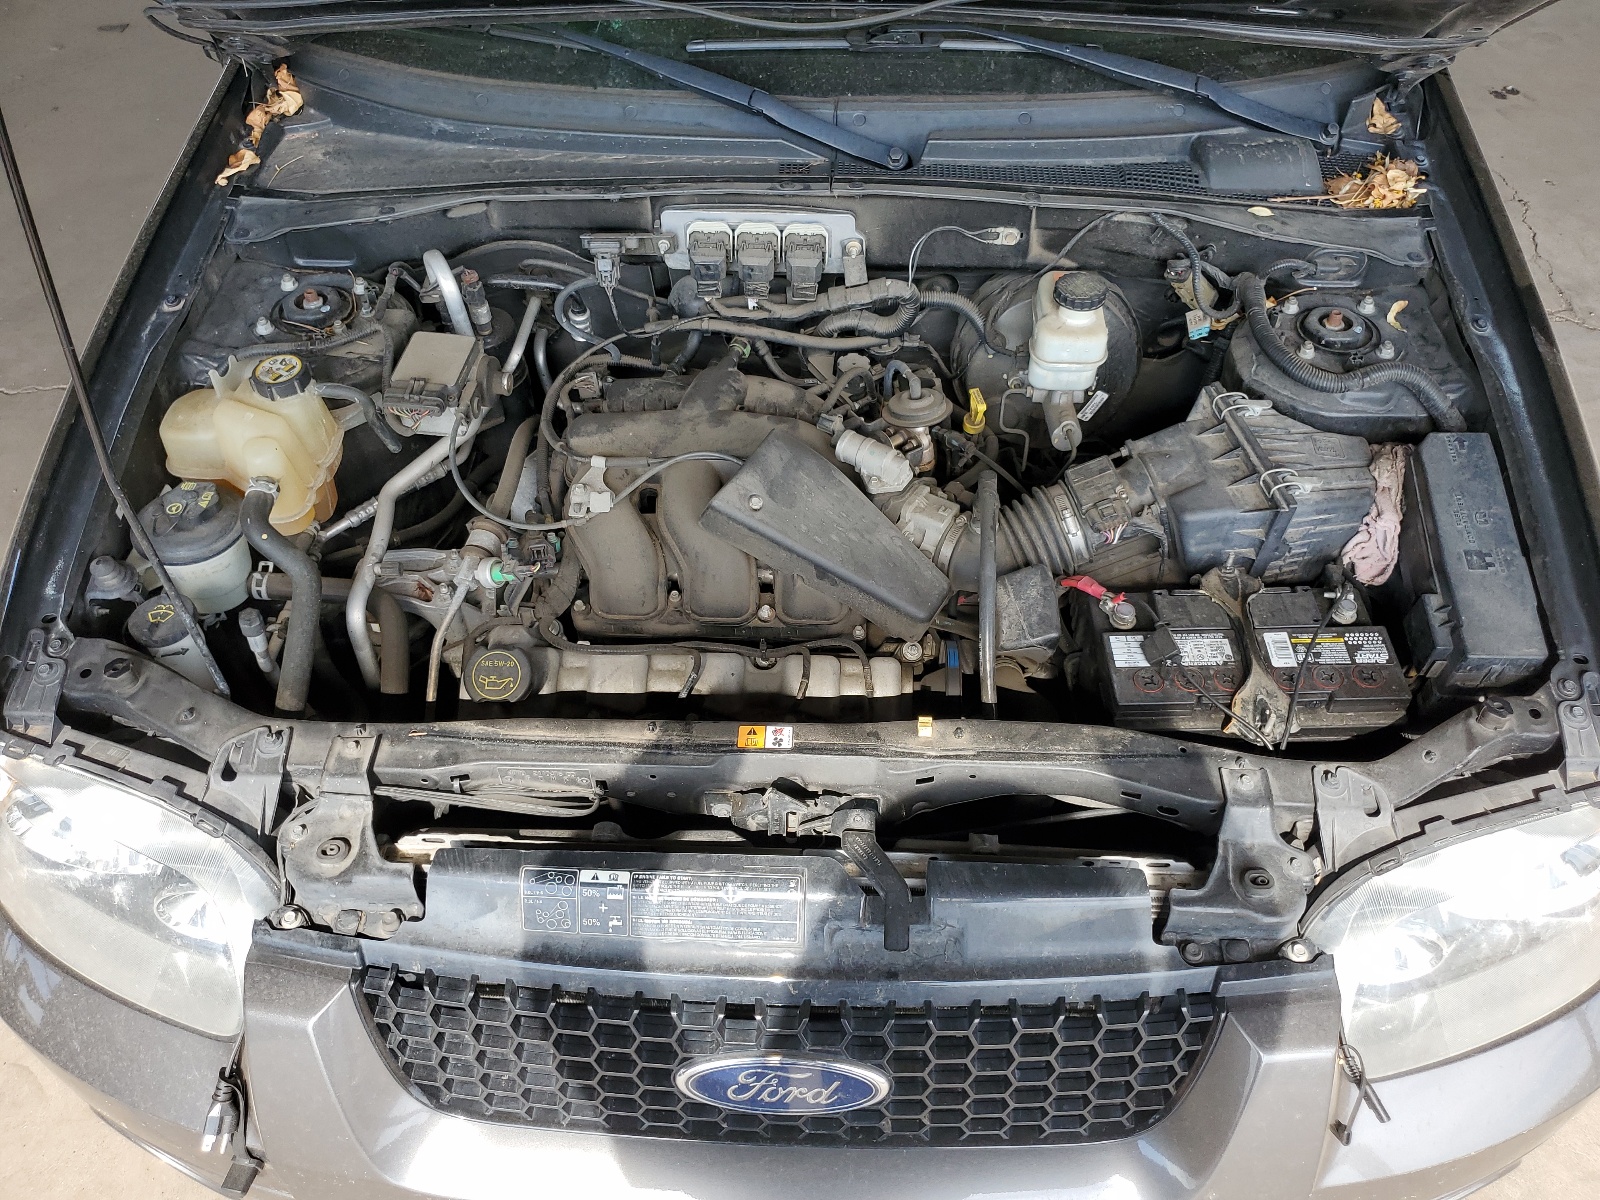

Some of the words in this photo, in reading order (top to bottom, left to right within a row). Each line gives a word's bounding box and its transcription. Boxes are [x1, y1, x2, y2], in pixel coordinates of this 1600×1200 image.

[582, 888, 601, 897] 50%
[582, 918, 601, 926] 50%
[727, 1069, 841, 1104] Ford
